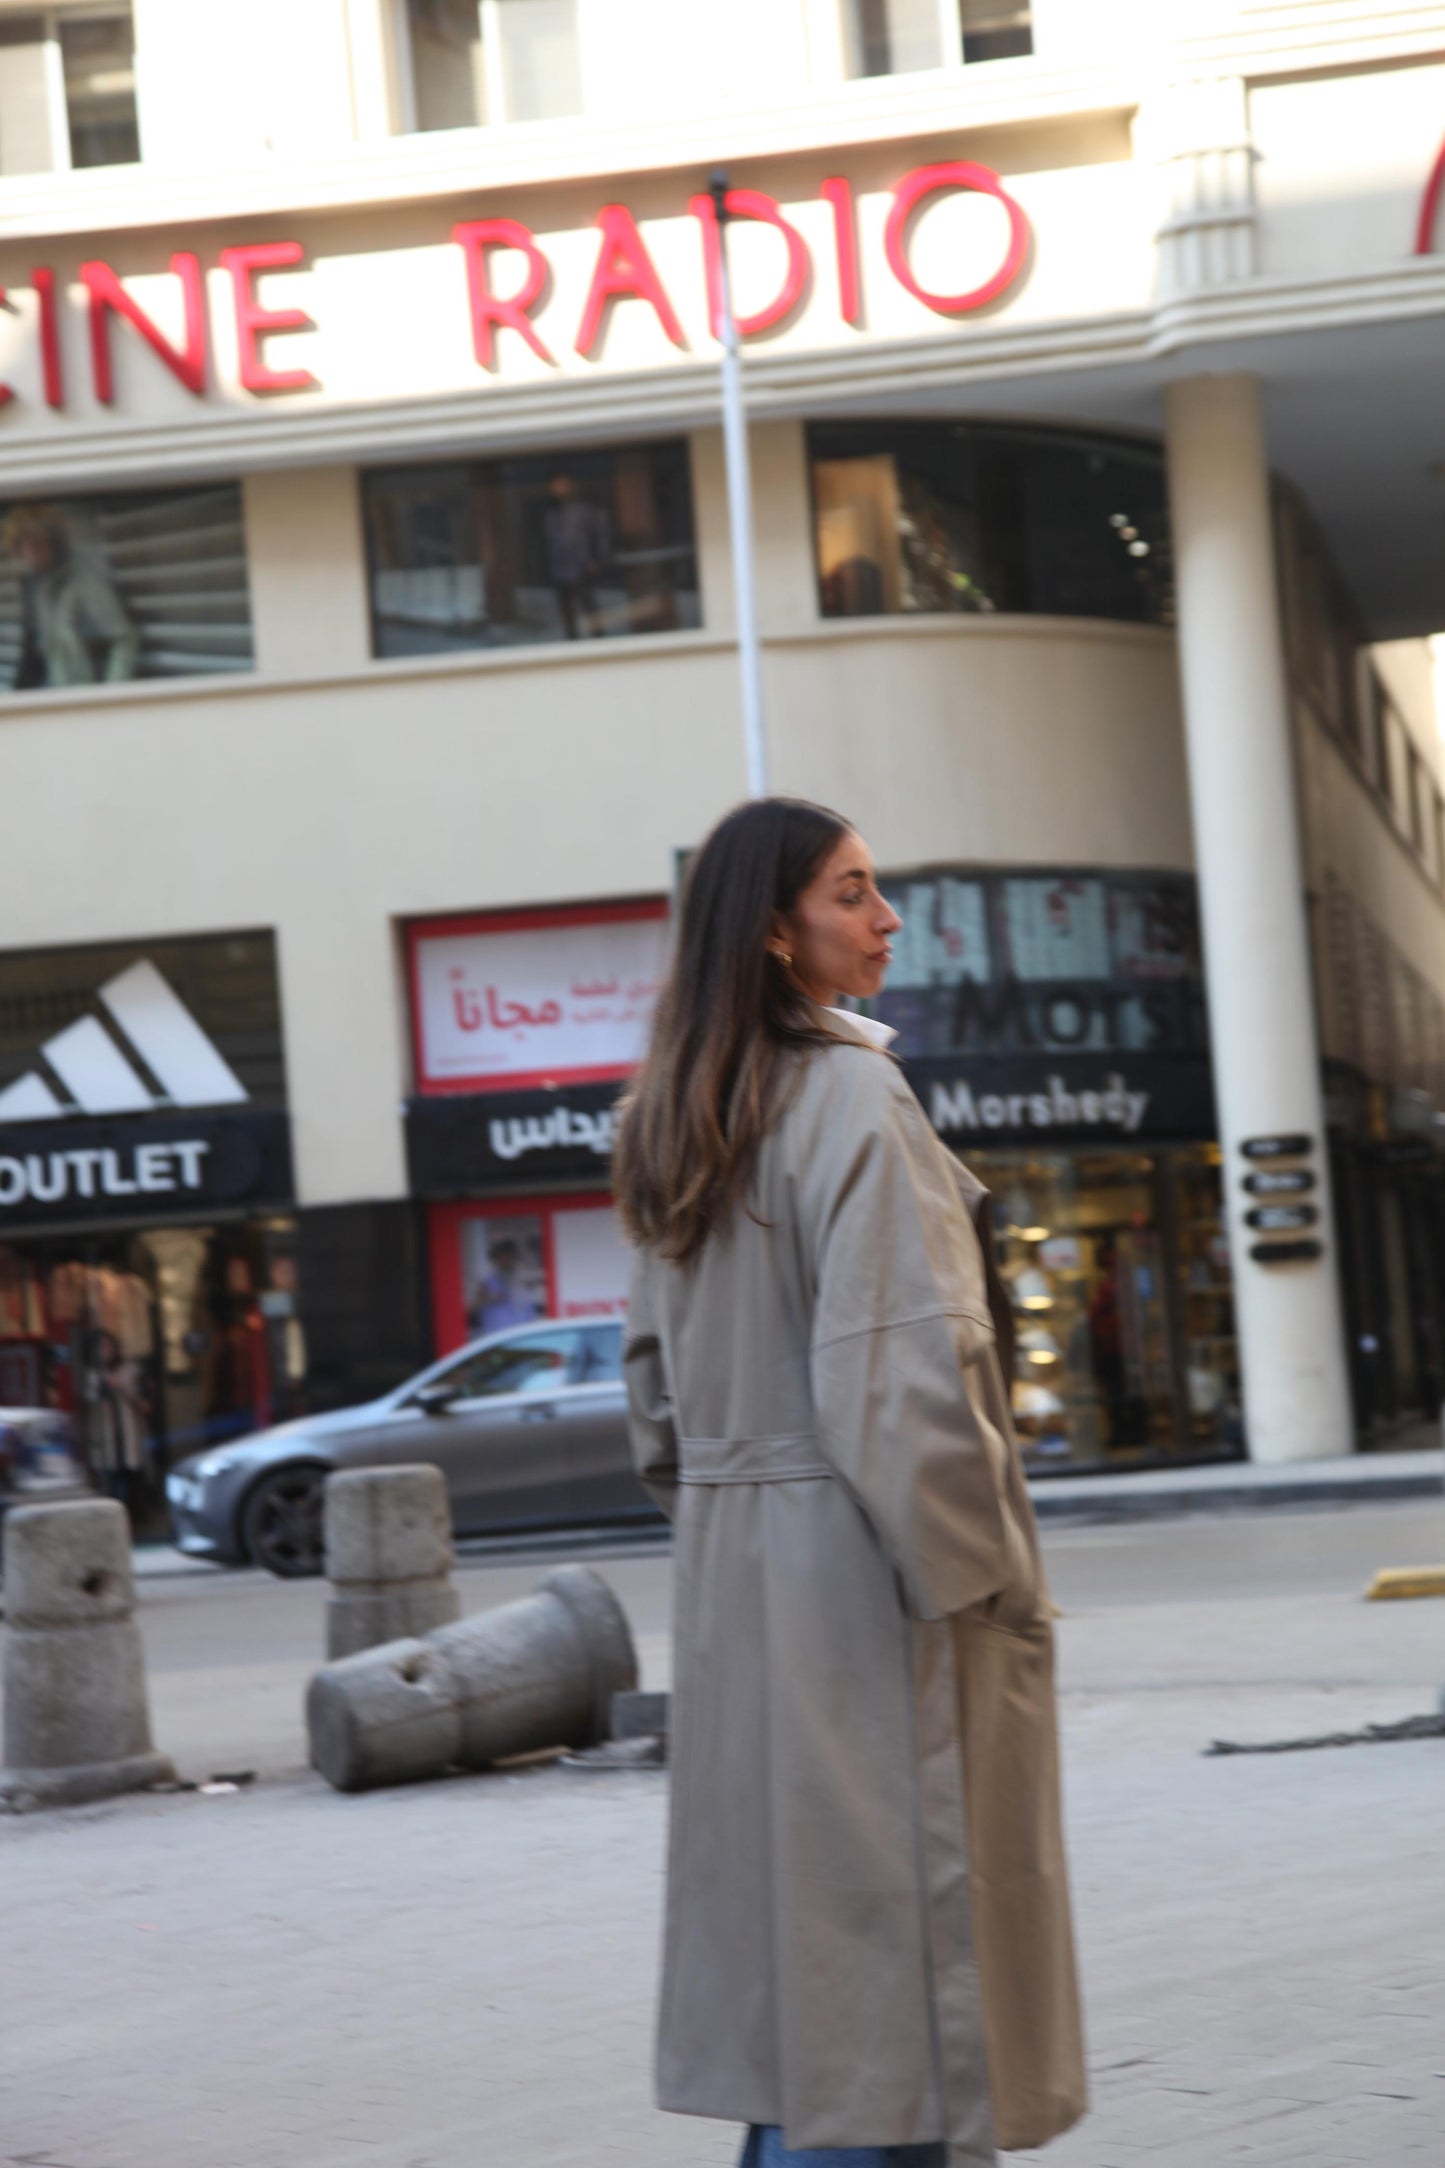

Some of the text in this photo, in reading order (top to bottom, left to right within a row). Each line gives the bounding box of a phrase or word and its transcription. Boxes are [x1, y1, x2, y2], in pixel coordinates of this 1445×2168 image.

[0, 161, 1031, 411] INE RADIO
[489, 1105, 624, 1161] يداس
[931, 1074, 1149, 1132] Morshedy
[0, 1139, 209, 1204] OUTLET
